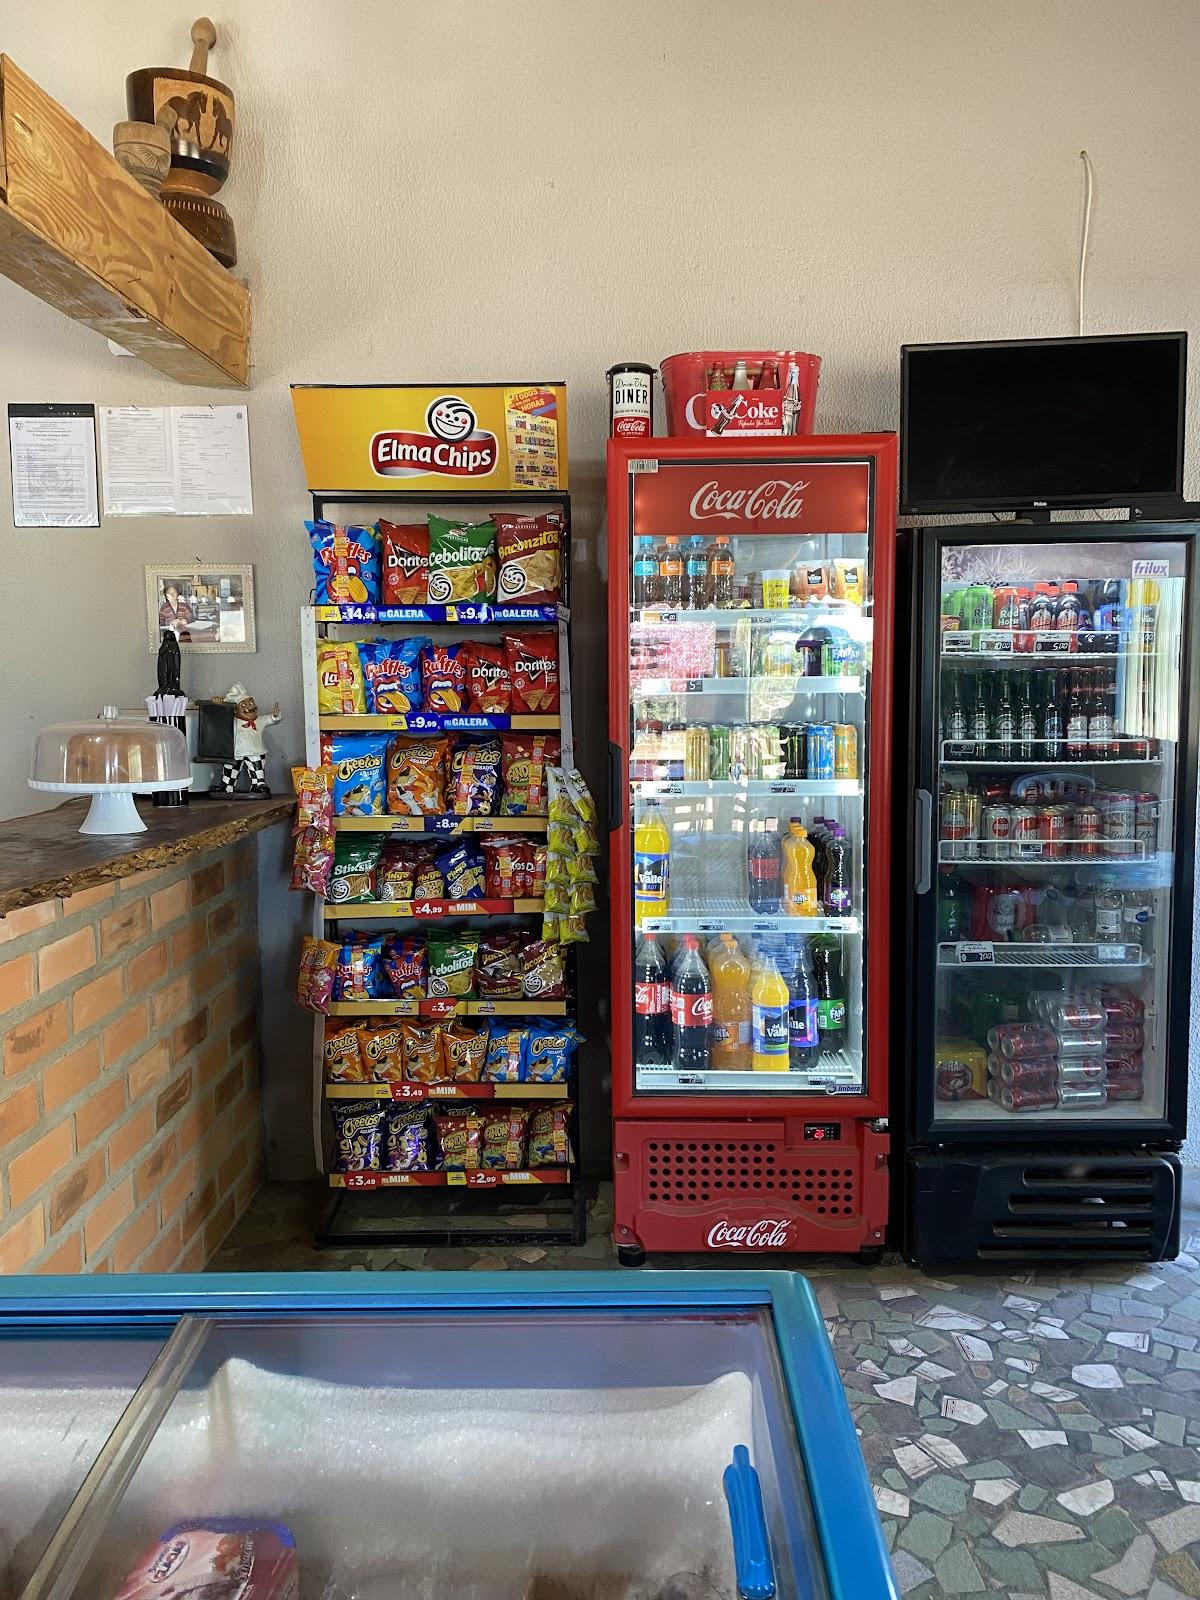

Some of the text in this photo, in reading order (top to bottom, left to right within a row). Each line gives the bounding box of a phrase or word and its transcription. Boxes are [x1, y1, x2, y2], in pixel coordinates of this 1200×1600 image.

[615, 388, 648, 405] DINER
[734, 399, 779, 419] Coke
[689, 479, 812, 521] Coca-Cola
[1133, 561, 1168, 577] frilux
[387, 608, 425, 619] GALERA
[502, 608, 540, 618] GALERA
[1000, 610, 1019, 618] Red
[998, 617, 1020, 626] Horse
[364, 657, 412, 682] Ruffles
[422, 654, 466, 678] Ruffles
[514, 660, 557, 673] Doritos
[415, 716, 438, 730] 9,99
[451, 717, 489, 727] GALERA
[390, 745, 437, 769] Cheetos
[336, 754, 383, 781] Cheetos
[441, 819, 459, 829] 8,99
[638, 873, 663, 884] Valle
[420, 902, 443, 915] 4,99
[456, 902, 477, 911] MIM
[437, 1002, 454, 1012] 3,99
[788, 1019, 806, 1030] alle
[766, 1028, 788, 1038] Valle
[448, 1038, 487, 1061] Cheetos
[530, 1035, 568, 1056] Cheetos
[401, 1085, 423, 1098] 3,49
[436, 1086, 456, 1095] MIM
[342, 1114, 380, 1139] Cheetos
[389, 1109, 428, 1134] Cheetos
[355, 1175, 376, 1186] 3,49
[389, 1175, 410, 1183] MIM
[476, 1173, 496, 1184] 2,99
[509, 1172, 530, 1180] MIM
[707, 1219, 793, 1249] Coca-Cola
